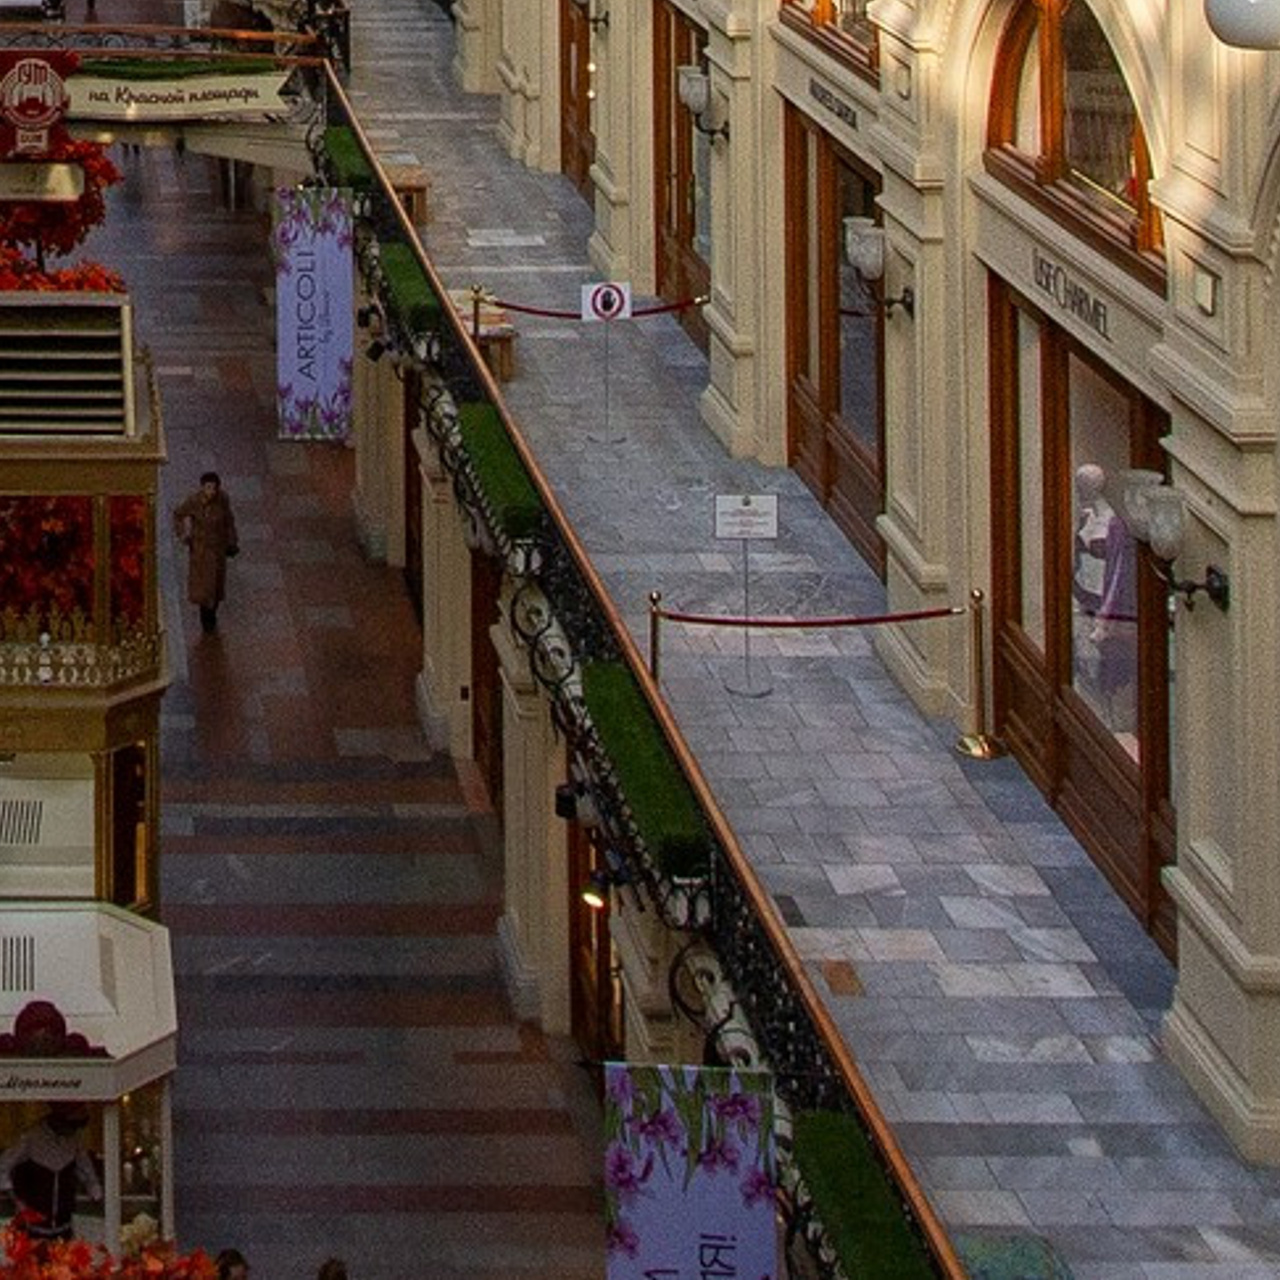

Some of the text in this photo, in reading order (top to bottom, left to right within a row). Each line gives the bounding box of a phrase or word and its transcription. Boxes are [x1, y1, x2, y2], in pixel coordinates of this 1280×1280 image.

[88, 91, 110, 102] на
[115, 86, 185, 107] Красной
[189, 87, 260, 104] площади
[297, 250, 317, 382] ARTICOLI
